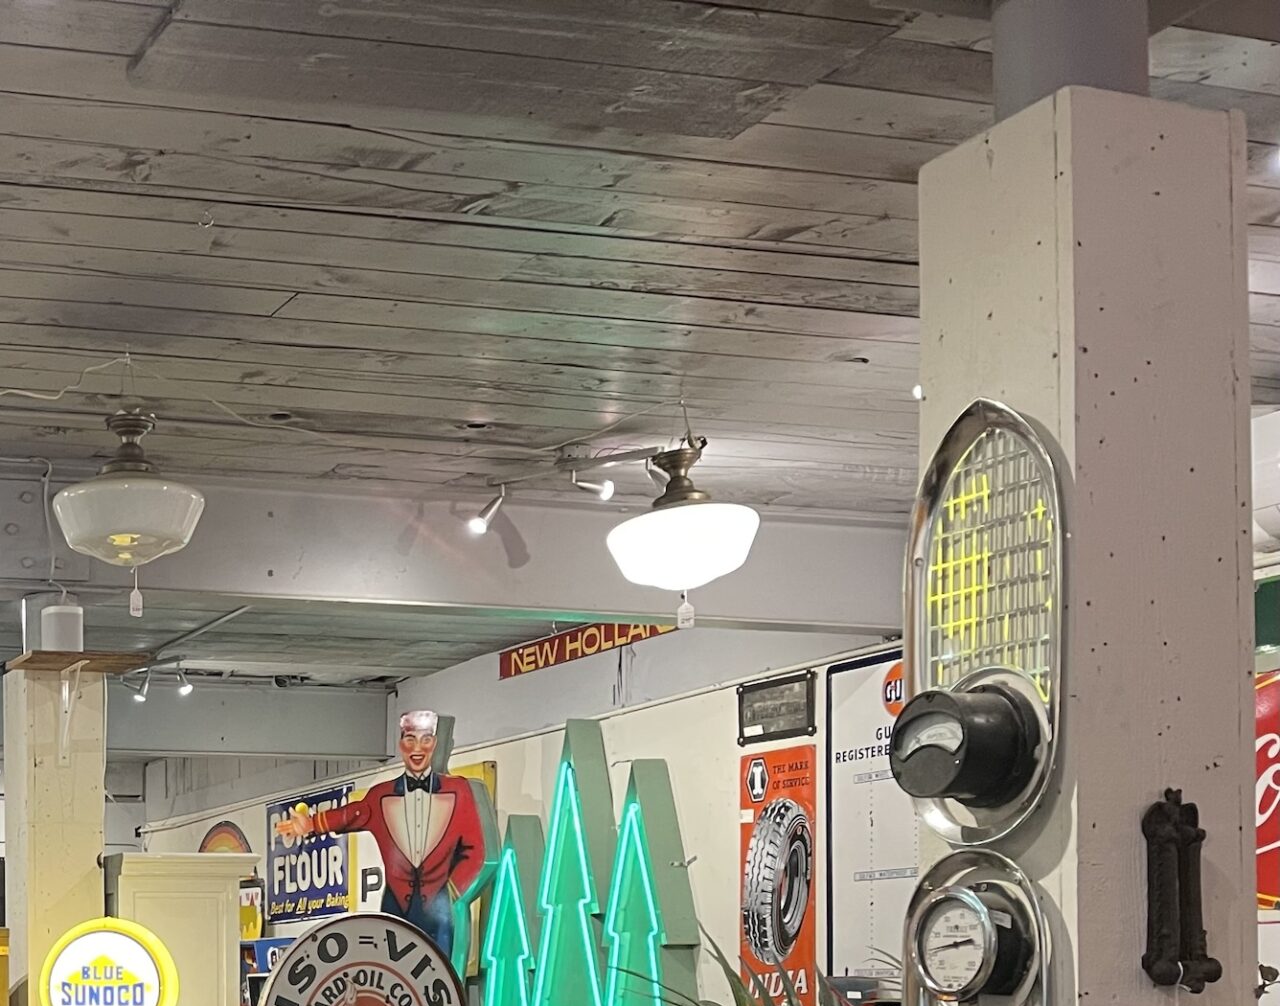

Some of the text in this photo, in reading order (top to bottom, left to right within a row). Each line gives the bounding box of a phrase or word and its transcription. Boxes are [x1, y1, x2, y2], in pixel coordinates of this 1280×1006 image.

[511, 638, 559, 676] NEW
[835, 744, 890, 764] REGISTERE
[788, 760, 808, 773] MARK
[782, 776, 810, 790] SERVICE
[273, 845, 344, 896] FLOUR
[284, 899, 295, 912] for
[296, 897, 308, 914] All
[307, 898, 324, 914] your
[325, 893, 349, 909] Baking
[81, 966, 124, 981] BLUE
[354, 969, 385, 991] OIL
[749, 968, 809, 999] INDIA
[61, 982, 145, 1006] SUNOCO
